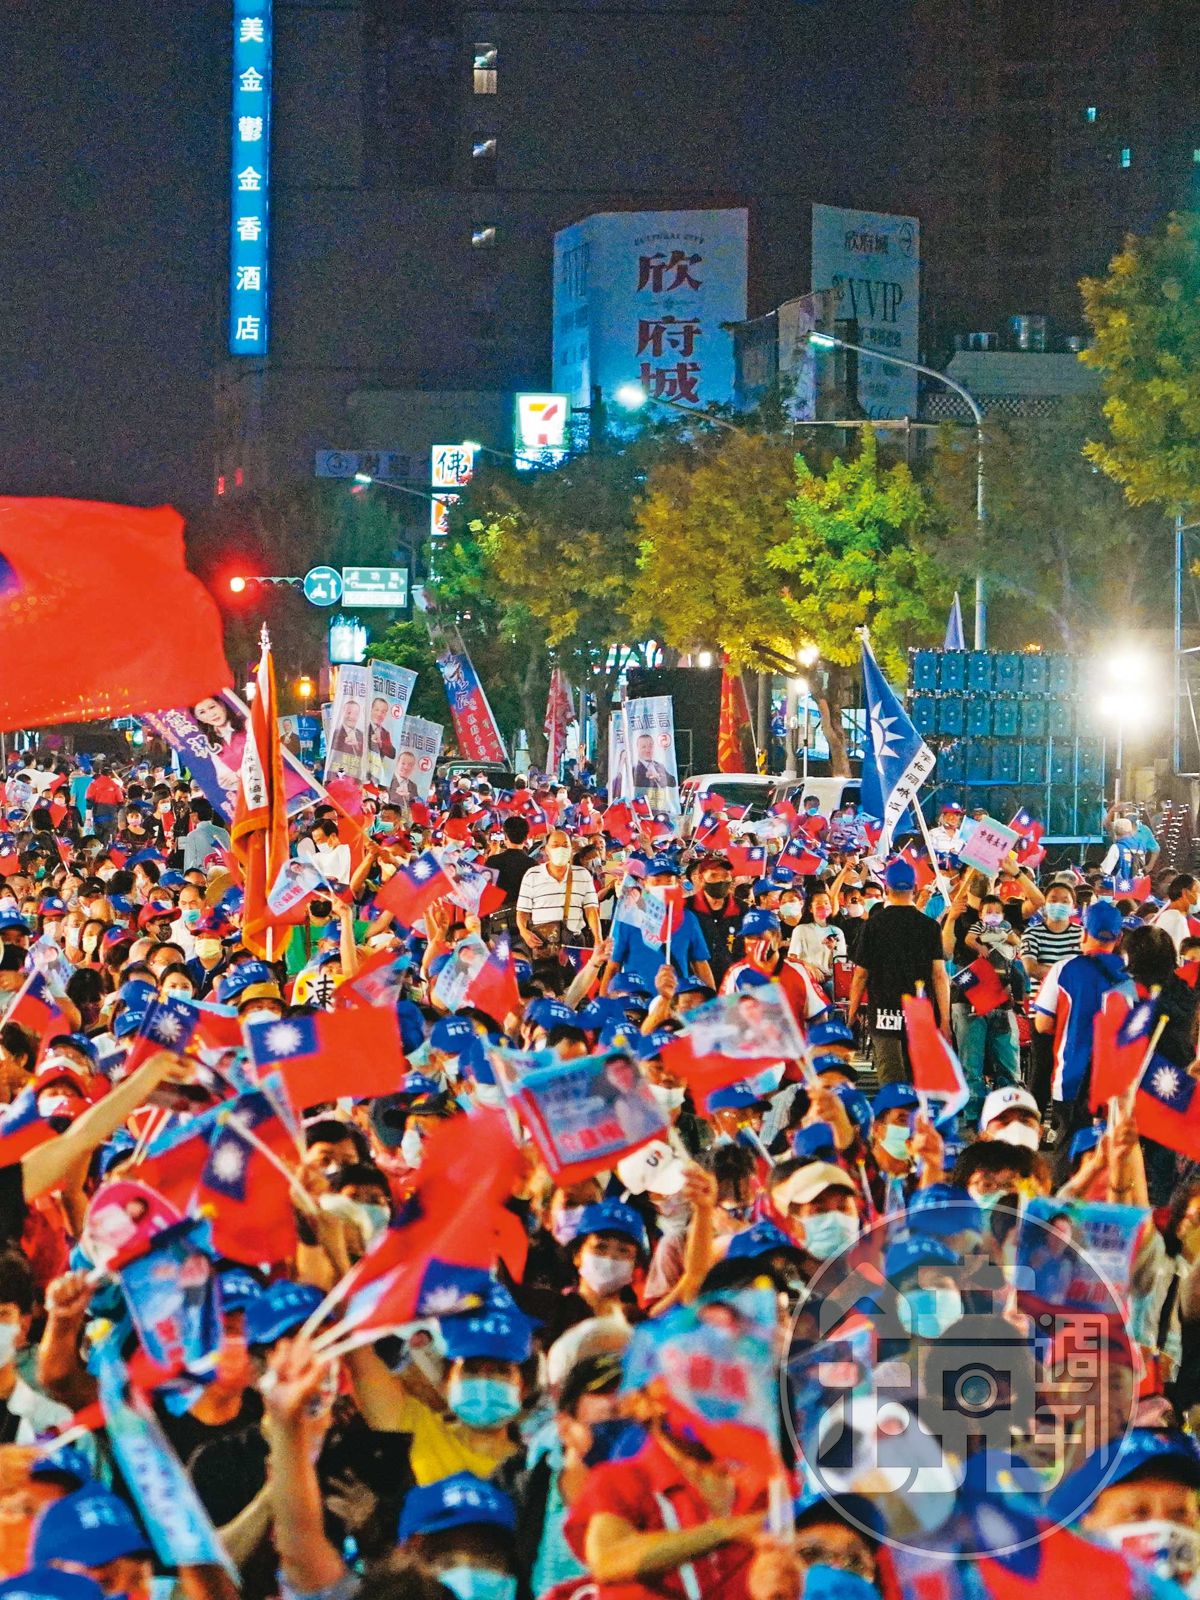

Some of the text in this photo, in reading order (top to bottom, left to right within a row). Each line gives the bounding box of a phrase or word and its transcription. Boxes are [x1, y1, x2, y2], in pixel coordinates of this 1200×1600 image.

[235, 17, 265, 342] 美金鬱金香酒店
[635, 250, 703, 403] 欣府城
[437, 451, 469, 484] 佛
